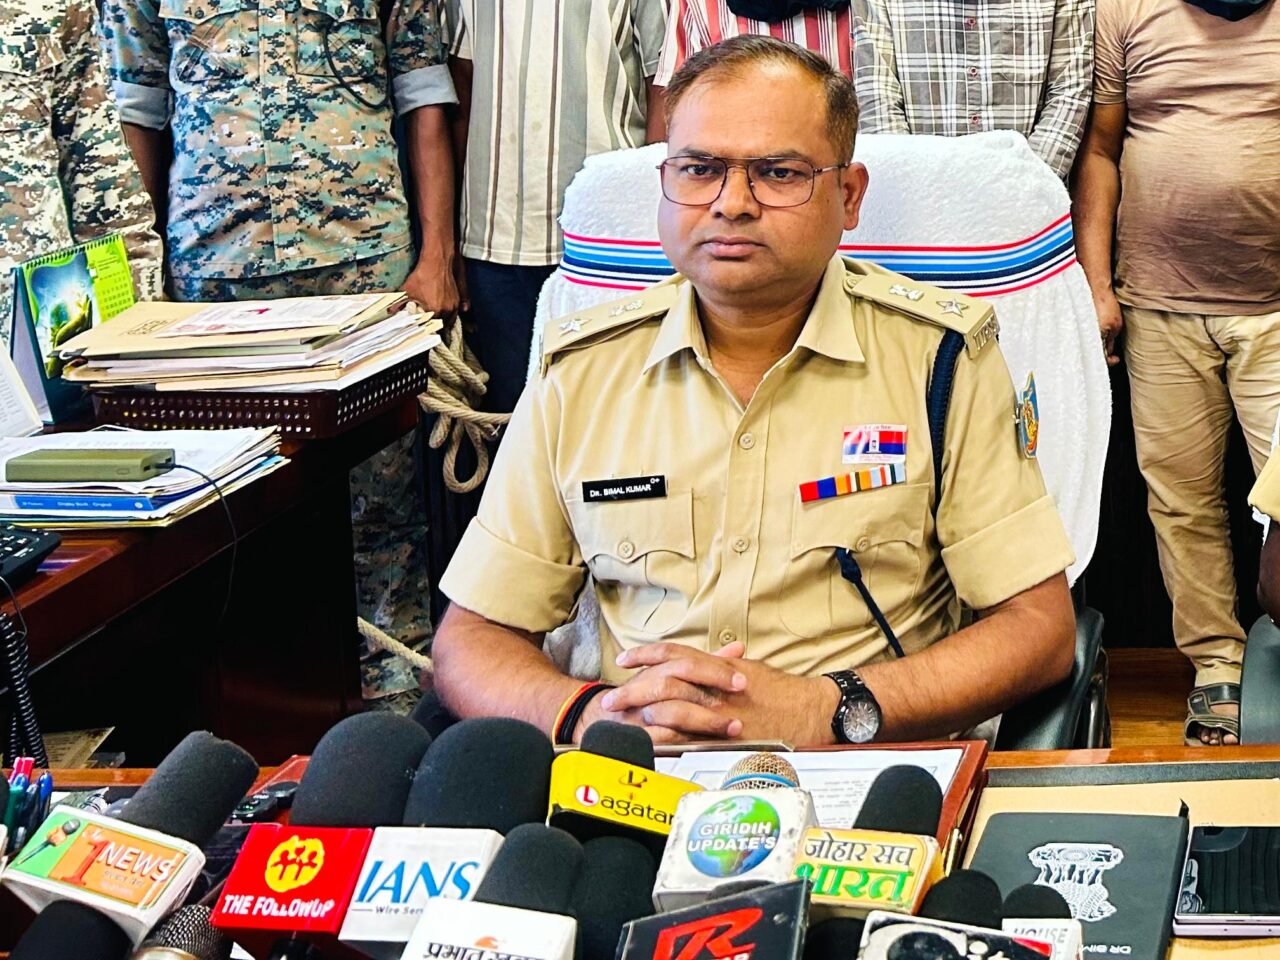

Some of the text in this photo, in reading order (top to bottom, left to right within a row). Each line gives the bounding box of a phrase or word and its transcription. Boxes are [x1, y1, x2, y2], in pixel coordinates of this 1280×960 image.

[603, 487, 626, 496] BIMAL
[626, 484, 652, 494] KUMAR
[700, 821, 772, 836] GIRIDIH
[687, 836, 776, 852] UPDATE'S
[805, 832, 917, 866] जोहार सच
[354, 860, 480, 904] IANS
[795, 863, 914, 901] भारत
[222, 894, 336, 918] THE FOLLOWUP
